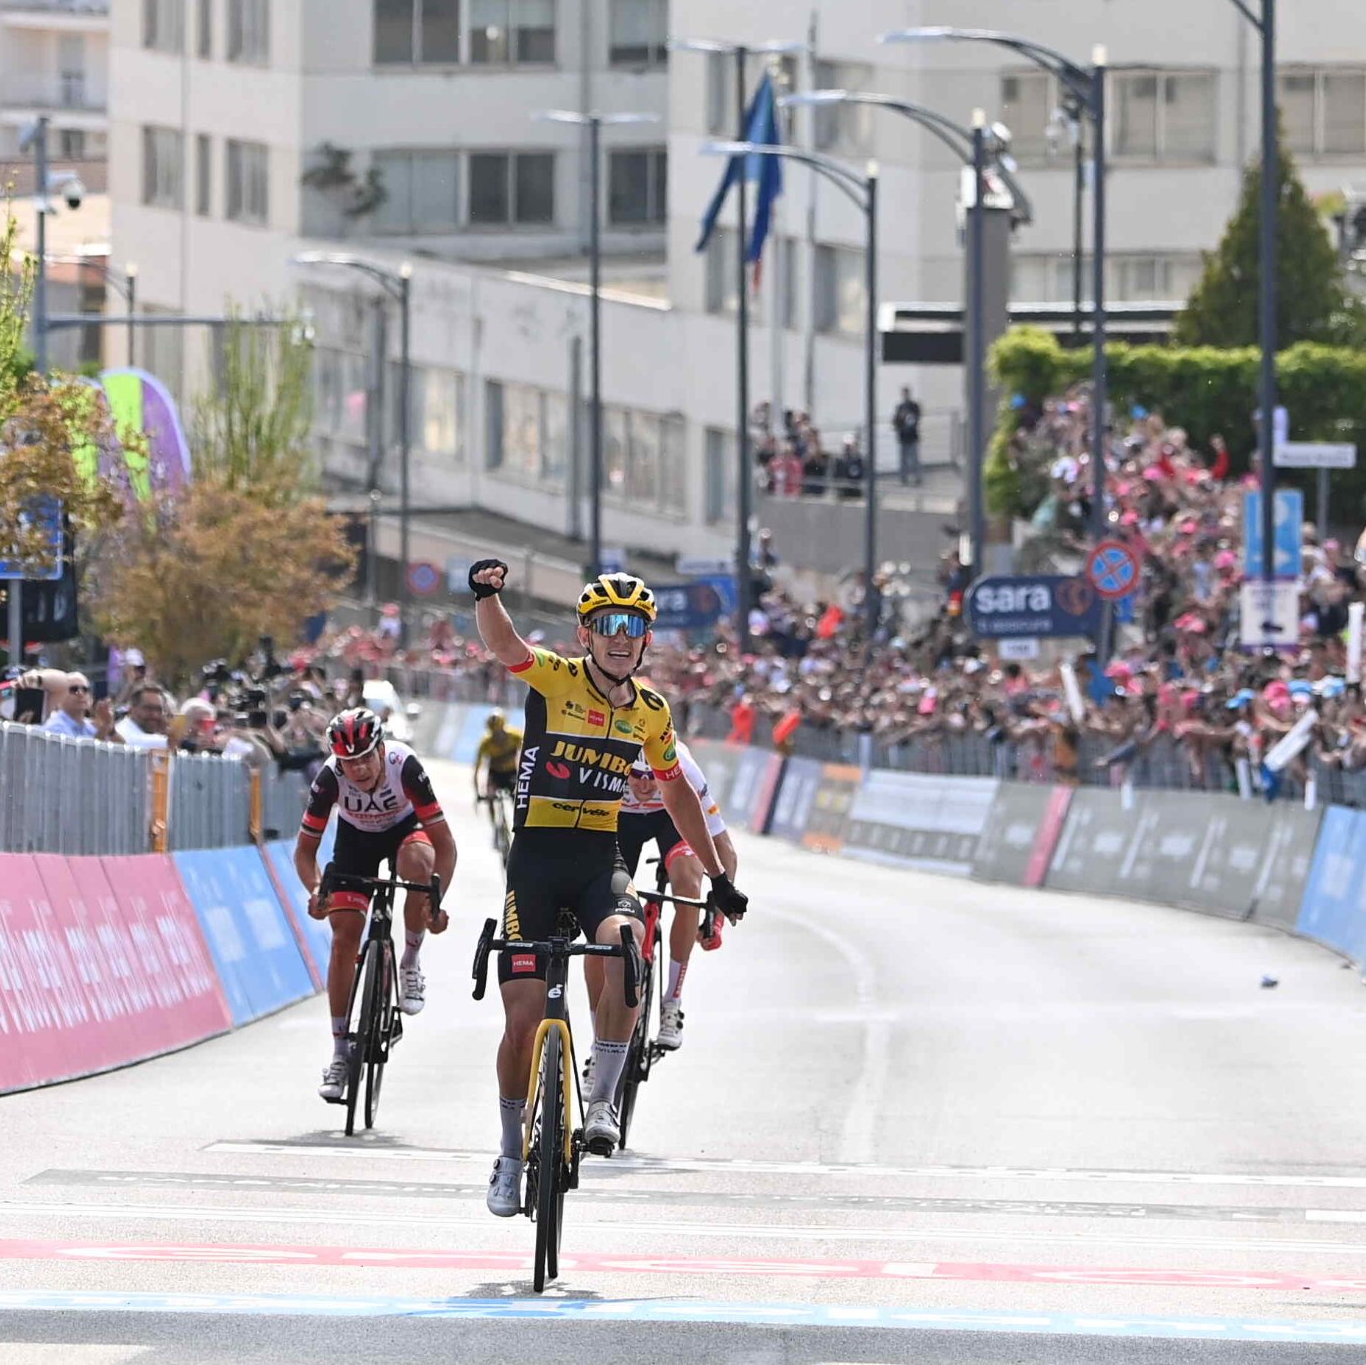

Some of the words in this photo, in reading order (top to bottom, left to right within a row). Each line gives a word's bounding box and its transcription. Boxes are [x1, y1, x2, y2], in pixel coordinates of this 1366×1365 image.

[975, 584, 1052, 614] sara
[549, 740, 633, 777] JUMBO
[516, 745, 540, 810] HEMA
[343, 794, 398, 813] UAE
